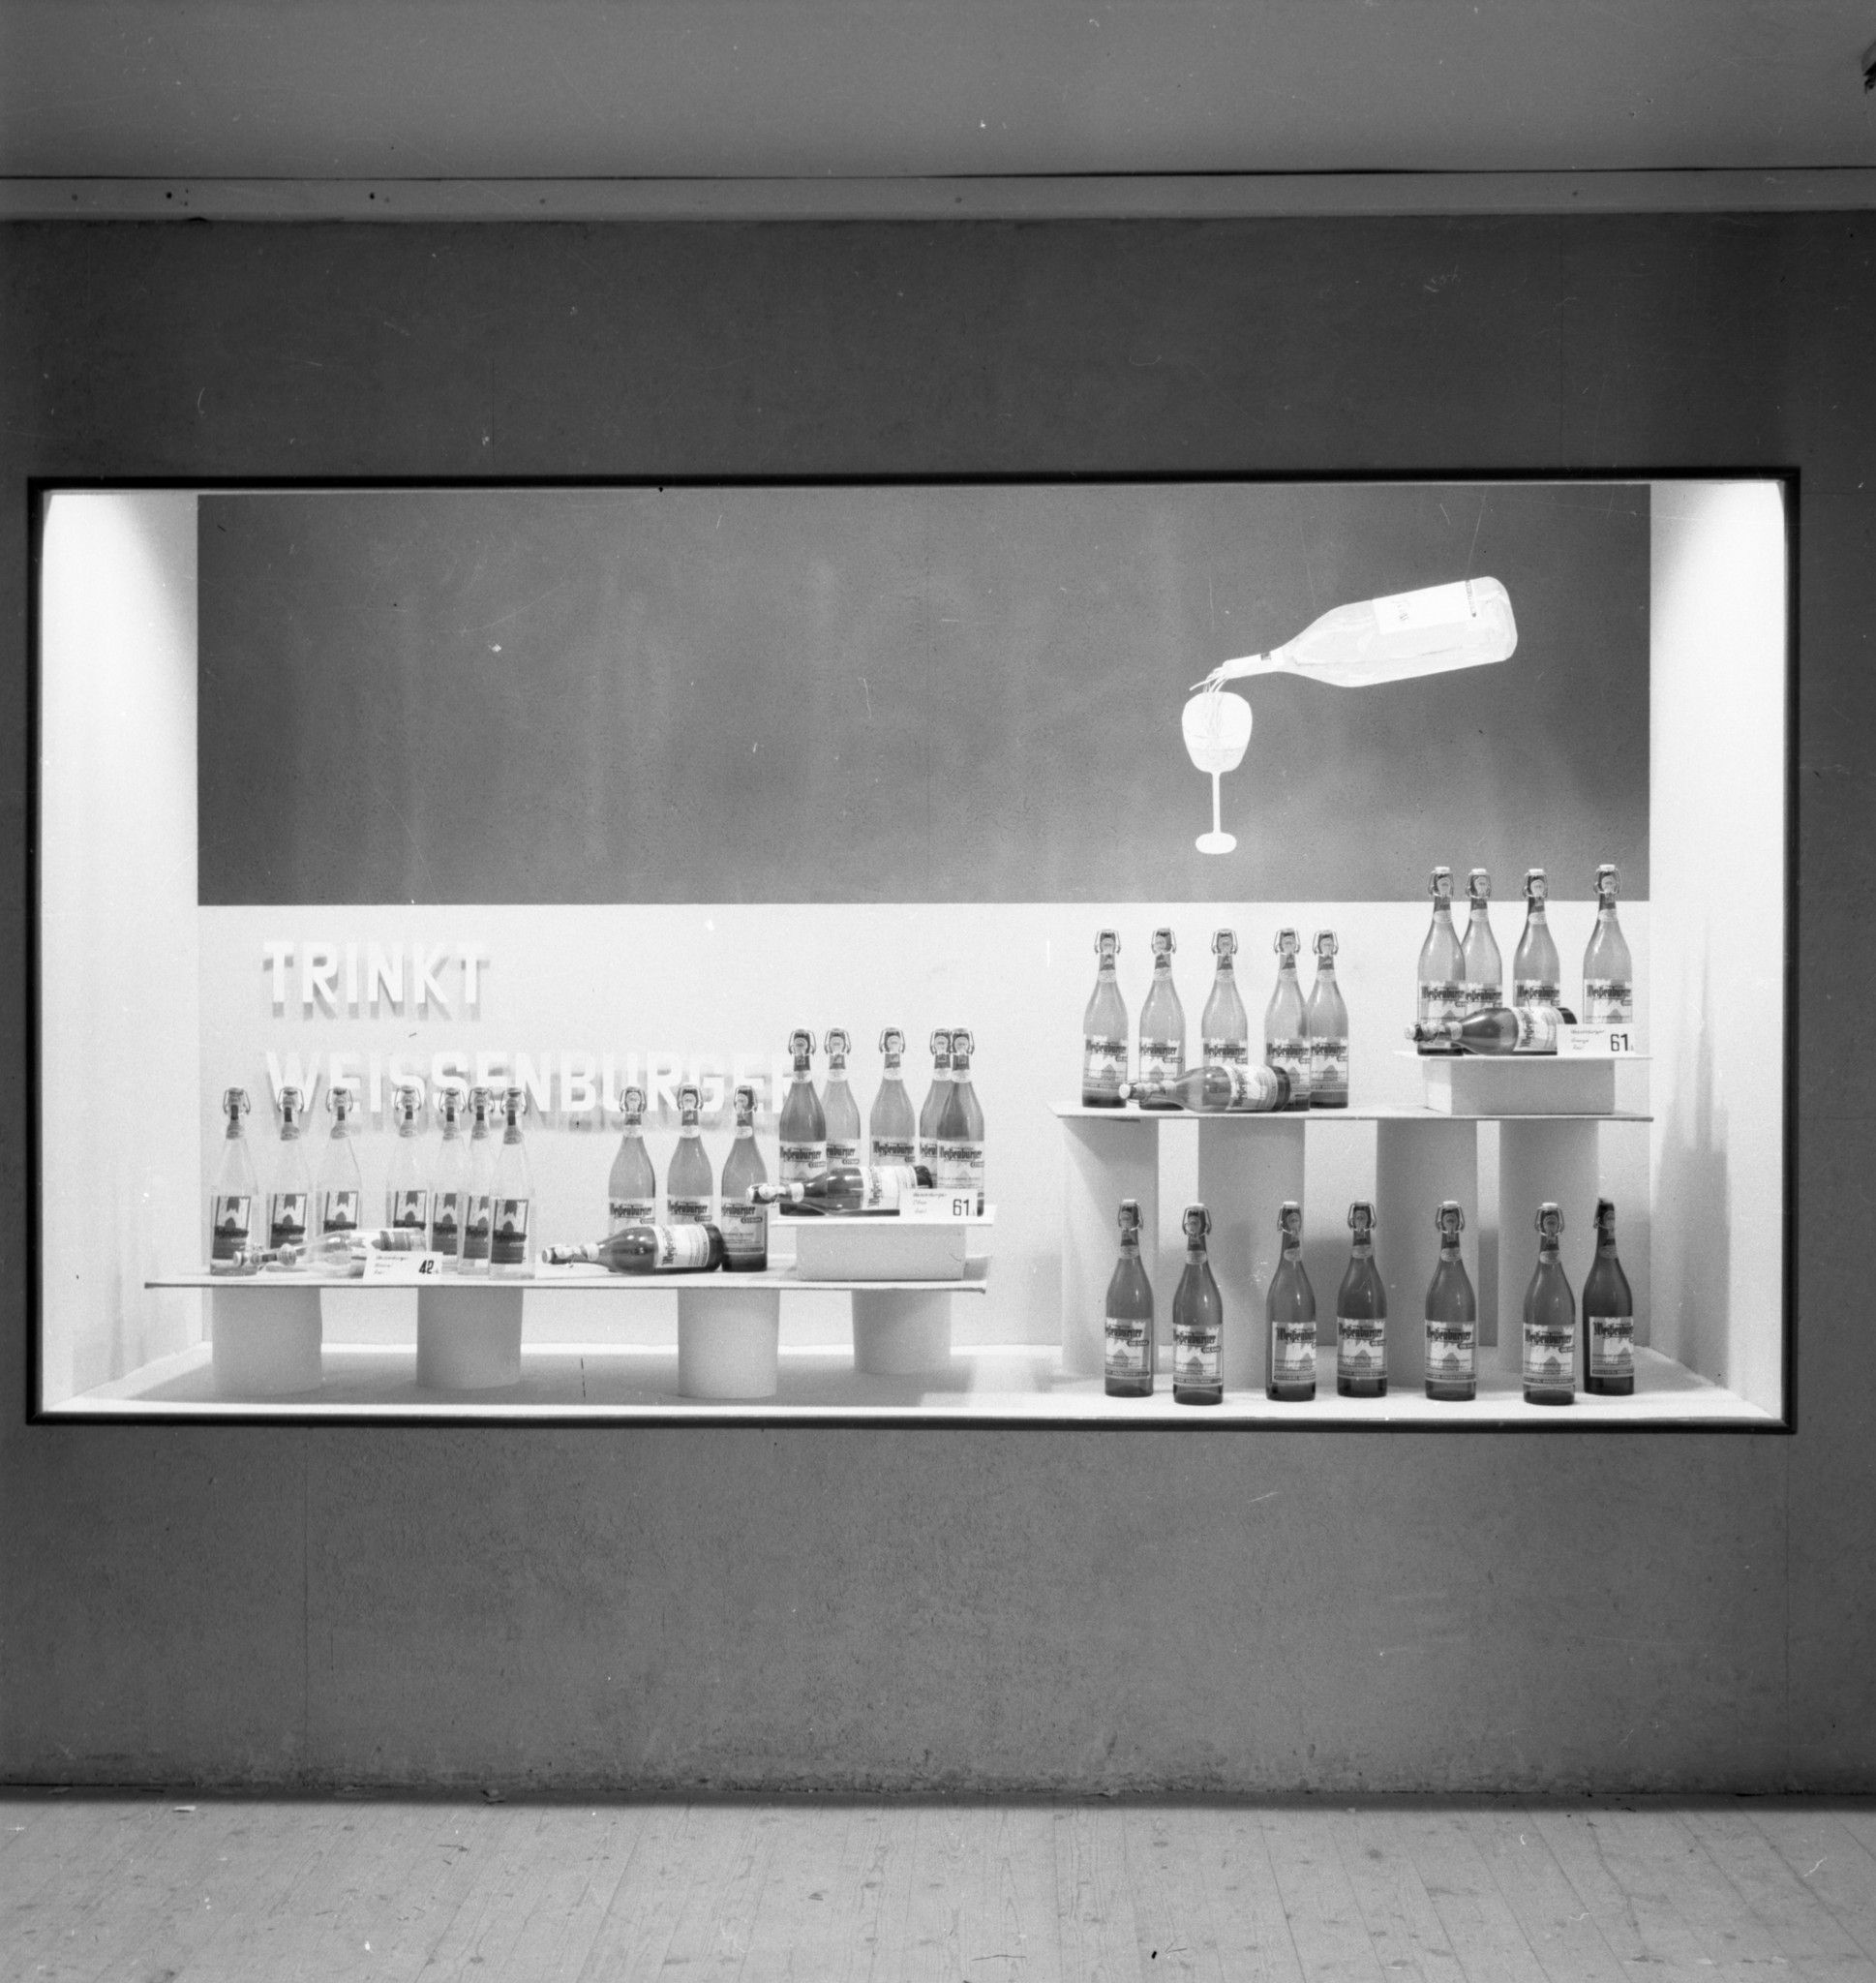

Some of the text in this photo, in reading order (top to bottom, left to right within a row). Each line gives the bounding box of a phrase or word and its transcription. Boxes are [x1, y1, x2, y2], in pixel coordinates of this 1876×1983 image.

[262, 940, 487, 1004] TRINKT
[1611, 1033, 1628, 1052] 61
[953, 1199, 970, 1216] 61
[418, 1259, 435, 1275] 42
